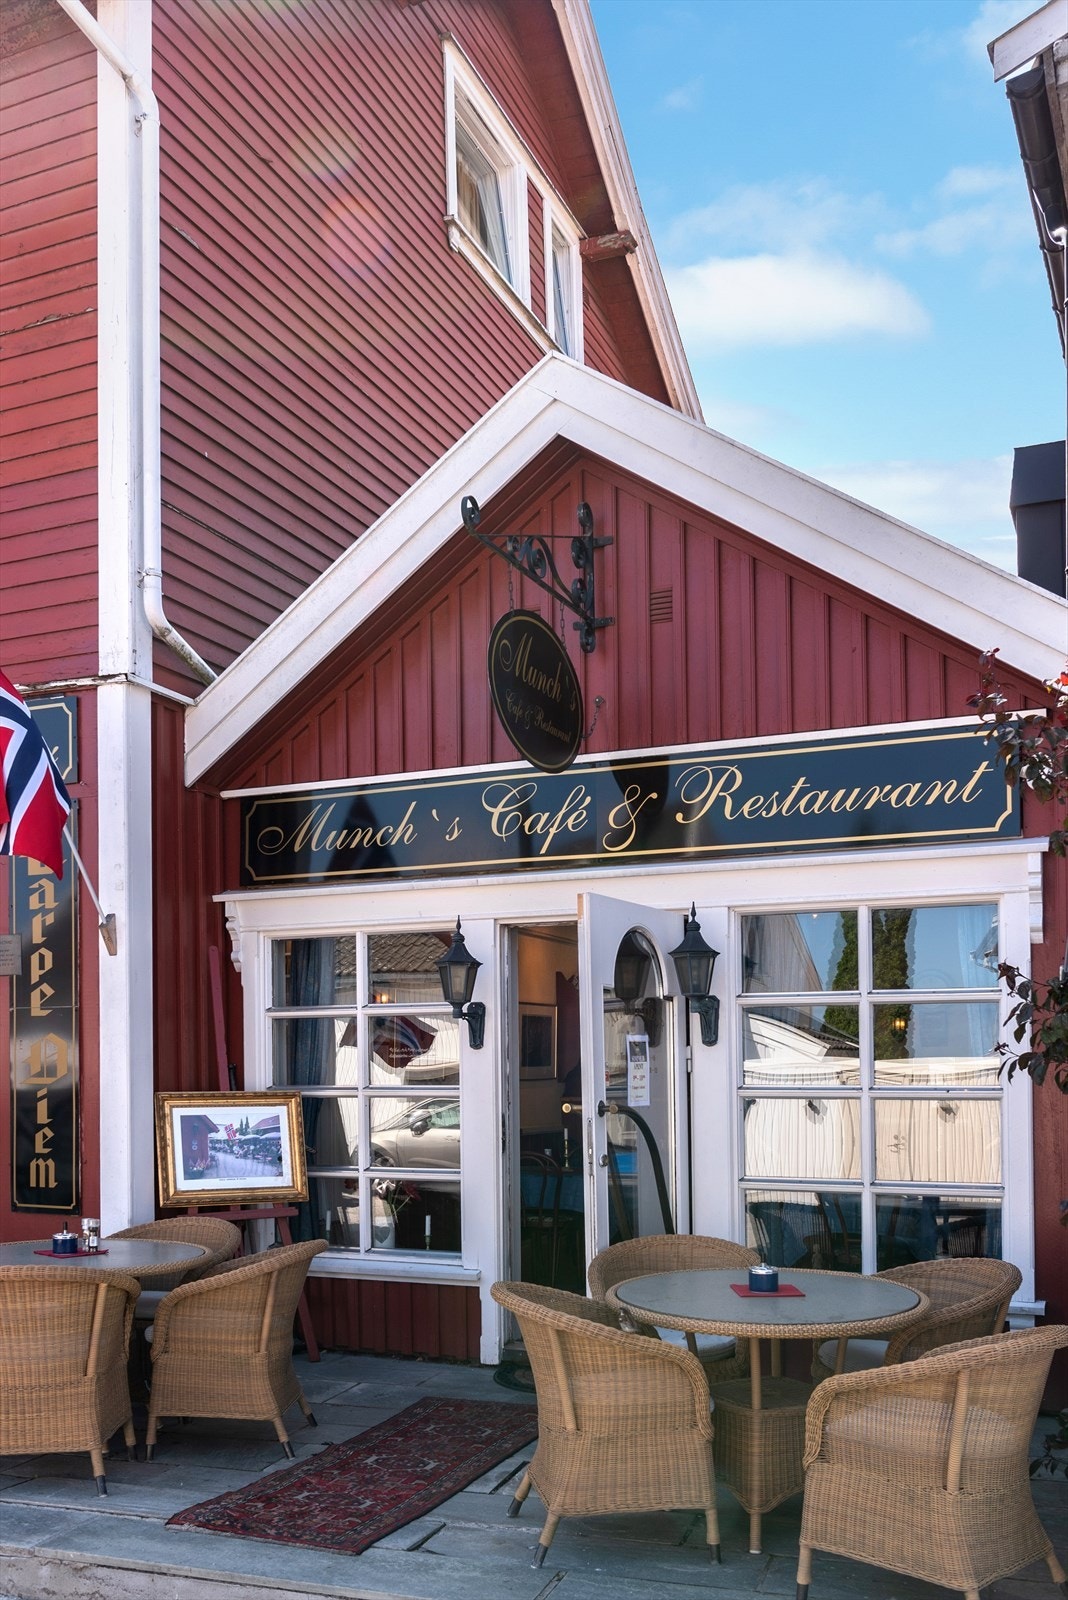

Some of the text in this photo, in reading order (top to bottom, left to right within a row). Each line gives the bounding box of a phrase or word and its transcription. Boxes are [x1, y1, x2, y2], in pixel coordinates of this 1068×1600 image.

[482, 782, 592, 855] Café
[602, 784, 658, 852] &
[674, 760, 994, 825] Restaurant
[20, 1032, 68, 1189] Diem
